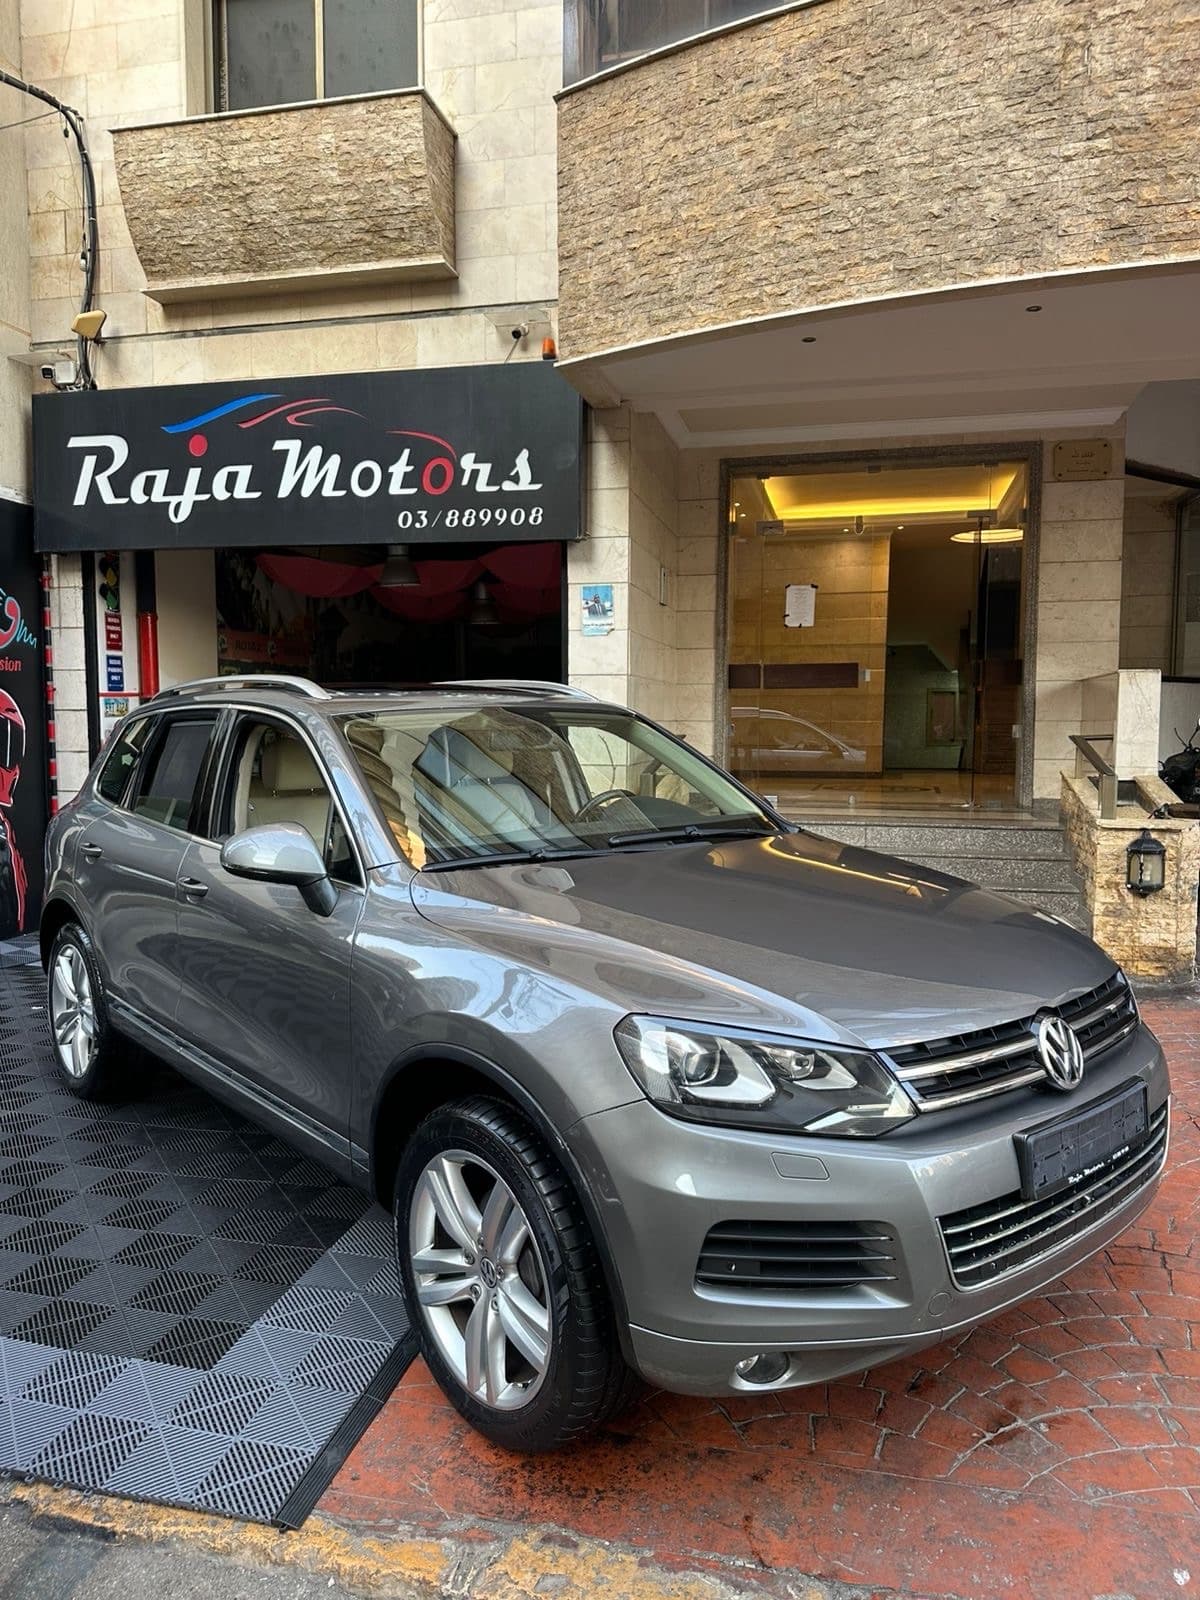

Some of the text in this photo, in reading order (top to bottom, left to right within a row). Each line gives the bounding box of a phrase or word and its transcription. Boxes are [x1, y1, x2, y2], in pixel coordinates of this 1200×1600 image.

[66, 431, 543, 524] Raja Motors
[397, 506, 543, 530] 03/889908
